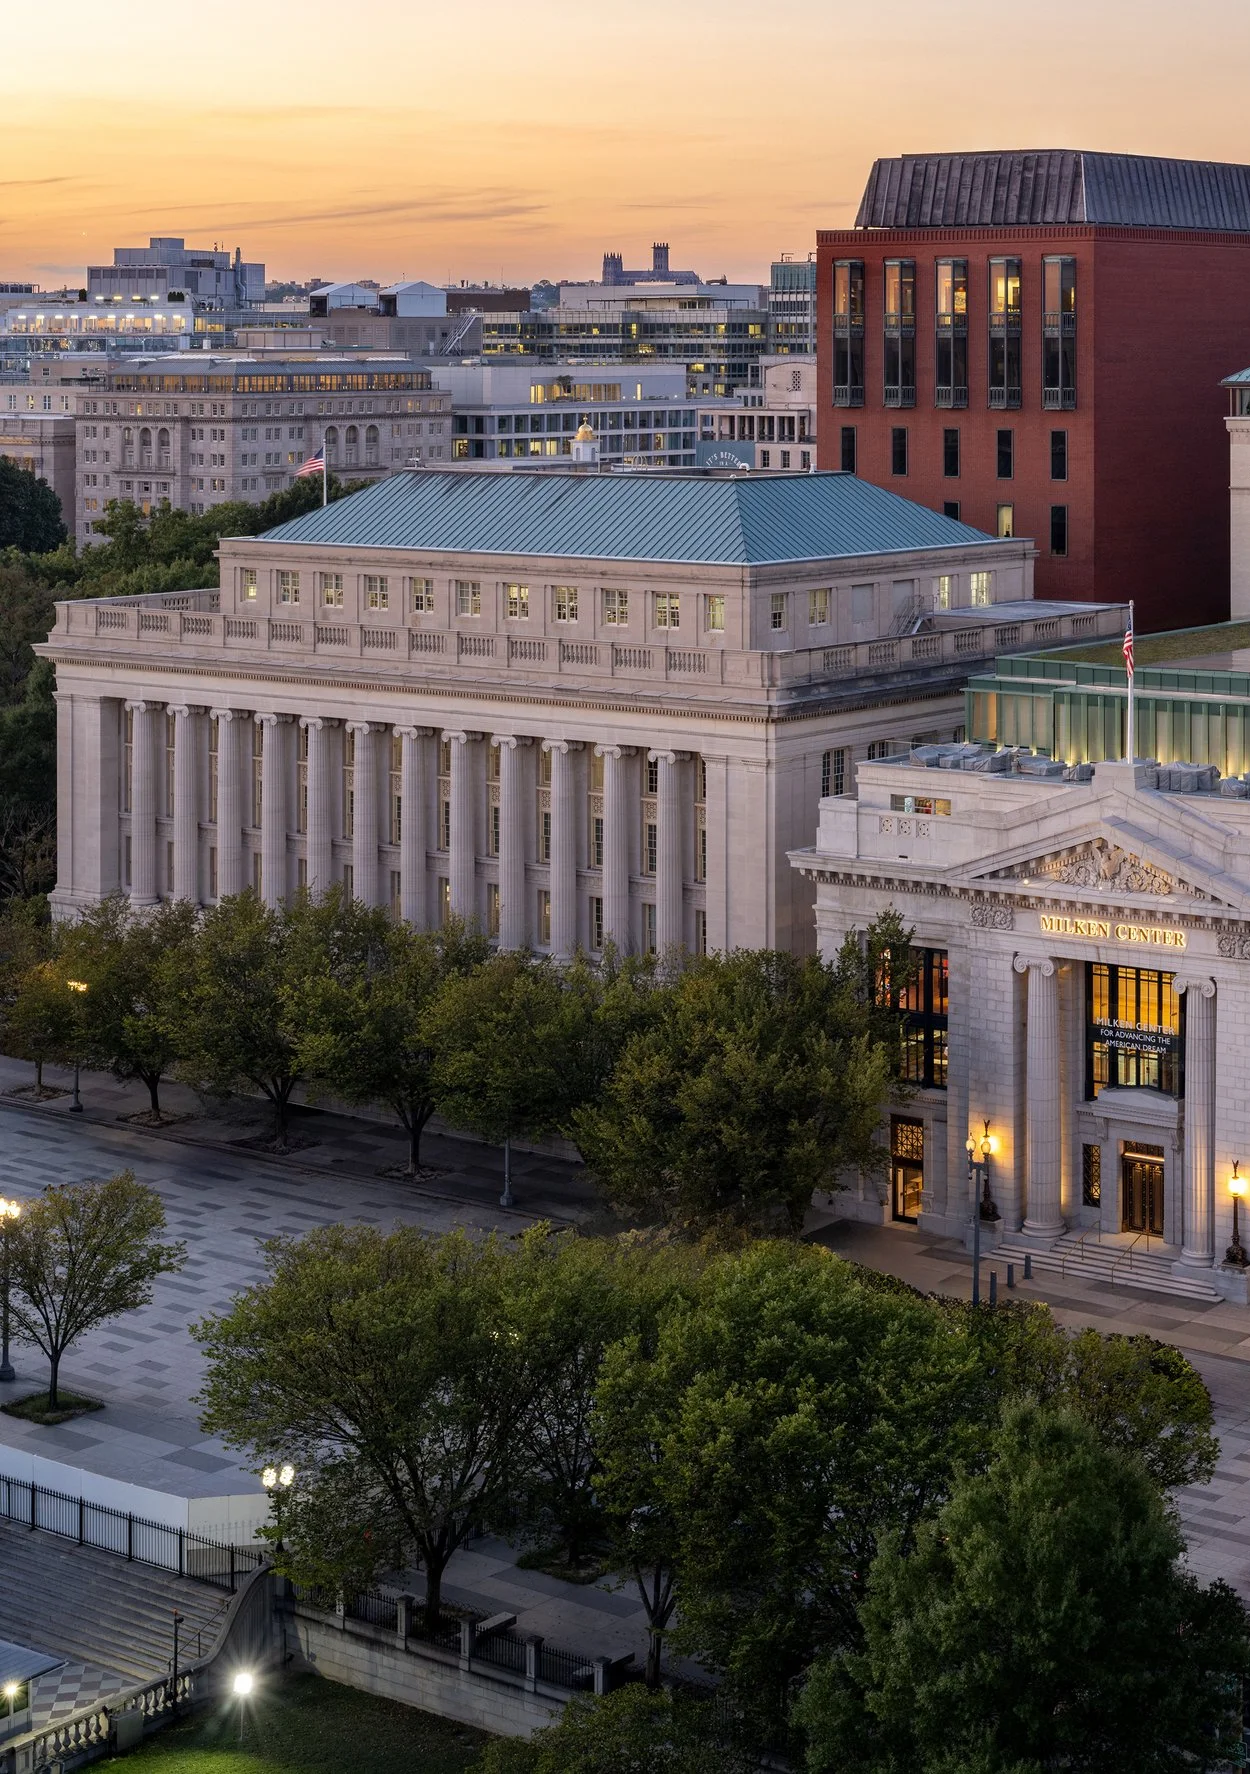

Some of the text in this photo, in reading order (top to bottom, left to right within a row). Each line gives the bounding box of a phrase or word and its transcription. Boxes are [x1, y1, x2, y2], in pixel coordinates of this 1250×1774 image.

[706, 453, 718, 466] IT'S
[1040, 915, 1186, 947] MILKEN CENTER
[1096, 1017, 1175, 1035] MILKEN CENTER
[1100, 1028, 1171, 1045] FOR ADVANCING THE
[1105, 1040, 1166, 1054] AMERICAN DREAM
